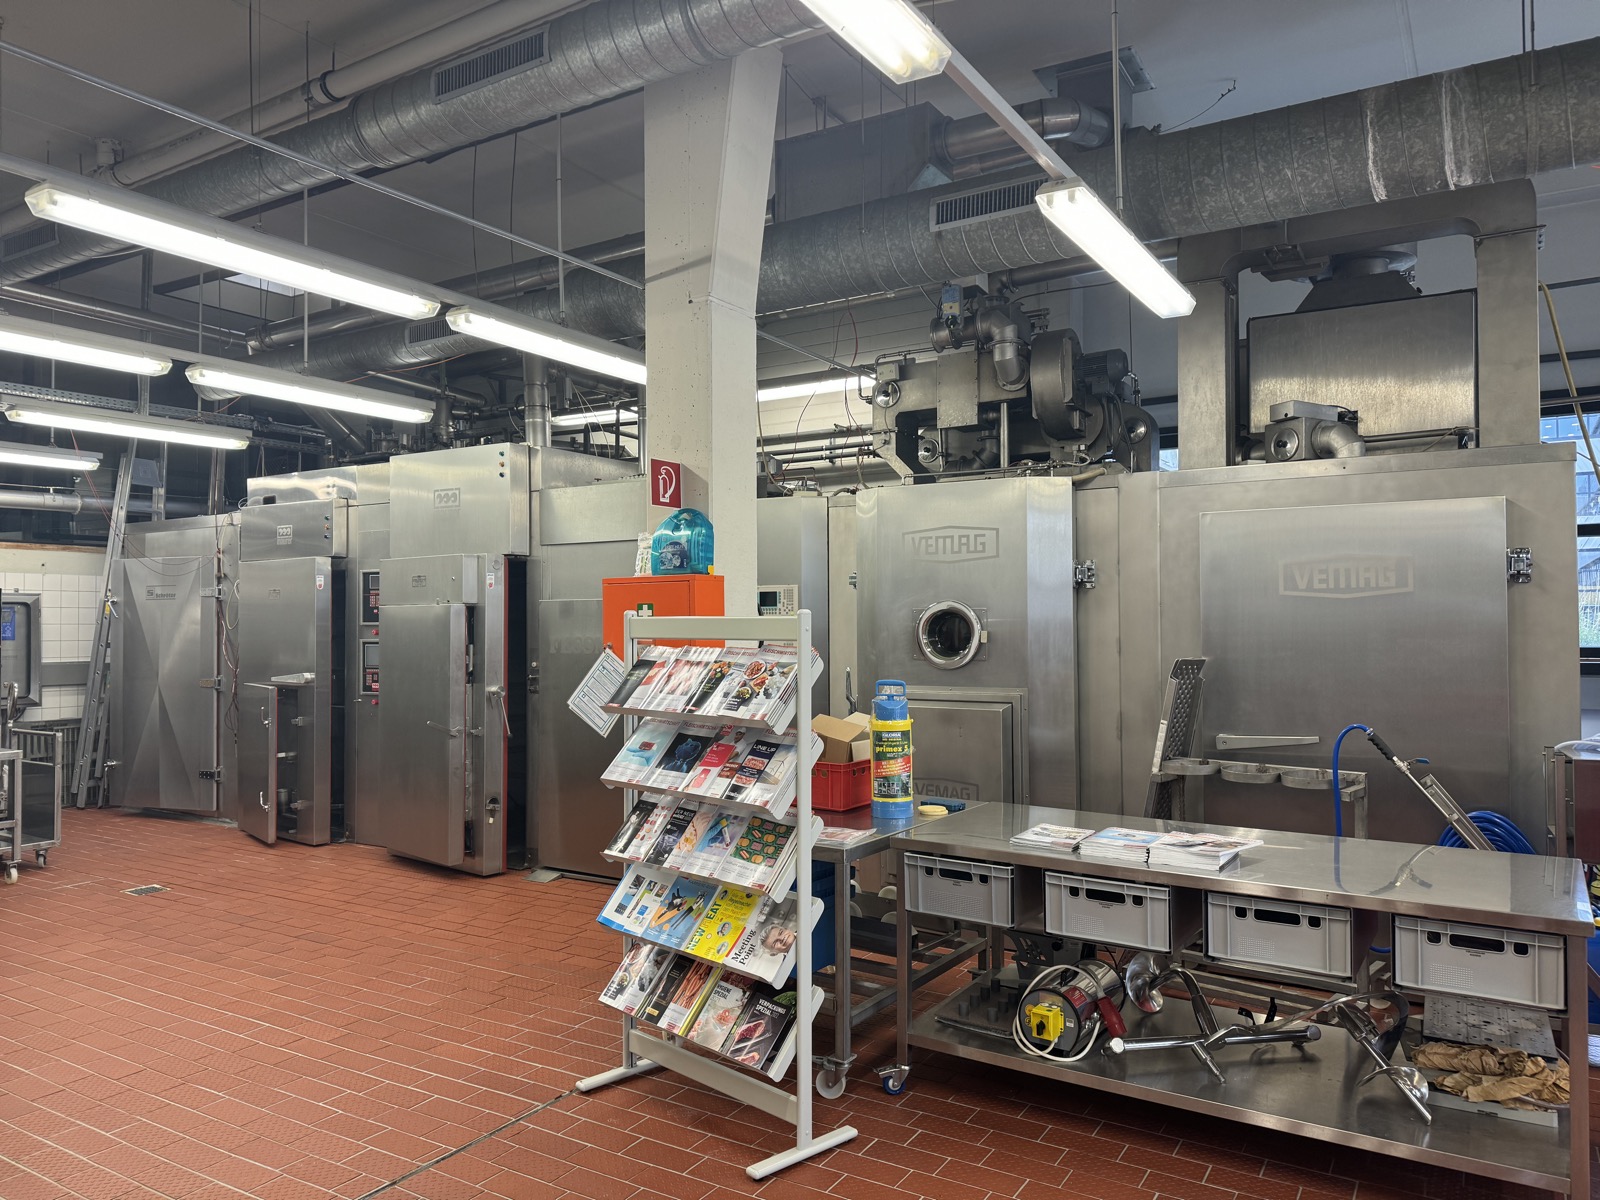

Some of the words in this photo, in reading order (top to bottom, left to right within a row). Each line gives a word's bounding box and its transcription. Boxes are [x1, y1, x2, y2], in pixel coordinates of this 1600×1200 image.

[911, 534, 986, 555] VEMAG
[1291, 560, 1397, 590] VEMAG
[876, 745, 902, 753] primex
[904, 744, 909, 752] 5
[914, 782, 971, 800] VEMAG
[732, 930, 756, 962] Meeting
[740, 944, 756, 965] Point
[713, 989, 729, 1000] SPEZIAL
[755, 1004, 772, 1016] SPEZIAL
